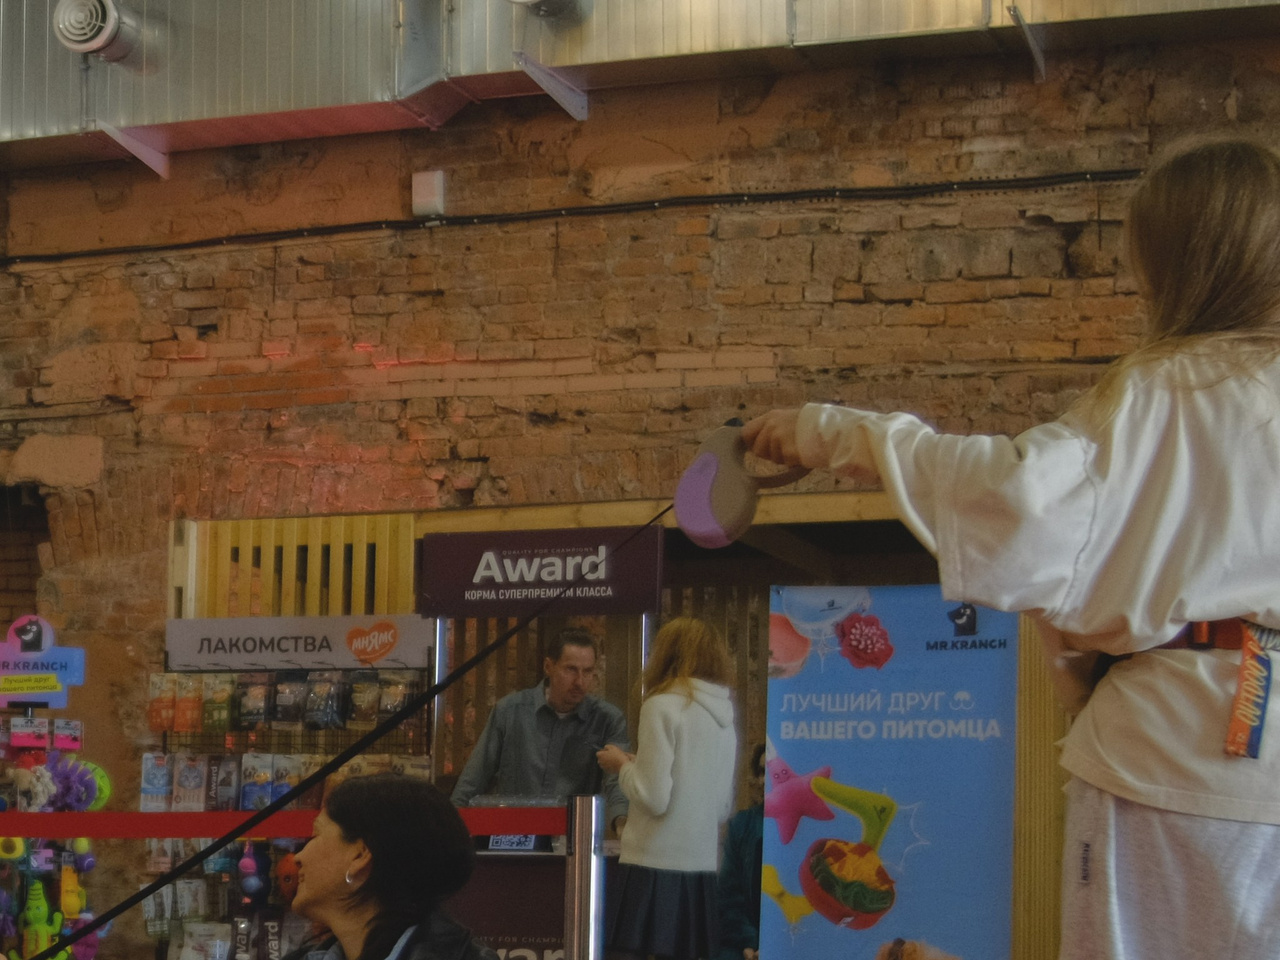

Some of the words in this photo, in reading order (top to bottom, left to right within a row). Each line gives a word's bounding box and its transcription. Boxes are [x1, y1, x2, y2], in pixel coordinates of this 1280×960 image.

[472, 545, 607, 583] Award
[465, 589, 496, 600] КОРМА
[576, 586, 613, 597] КЛАССА
[197, 635, 333, 654] ЛАКОМСТВА
[926, 639, 1007, 651] MR.KRANCH
[780, 688, 882, 712] ЛУЧШИЙ
[887, 691, 946, 714] ДРУГ
[780, 719, 877, 740] ВАШЕГО
[882, 718, 1001, 741] ПИТОМЦА
[210, 766, 218, 798] Award
